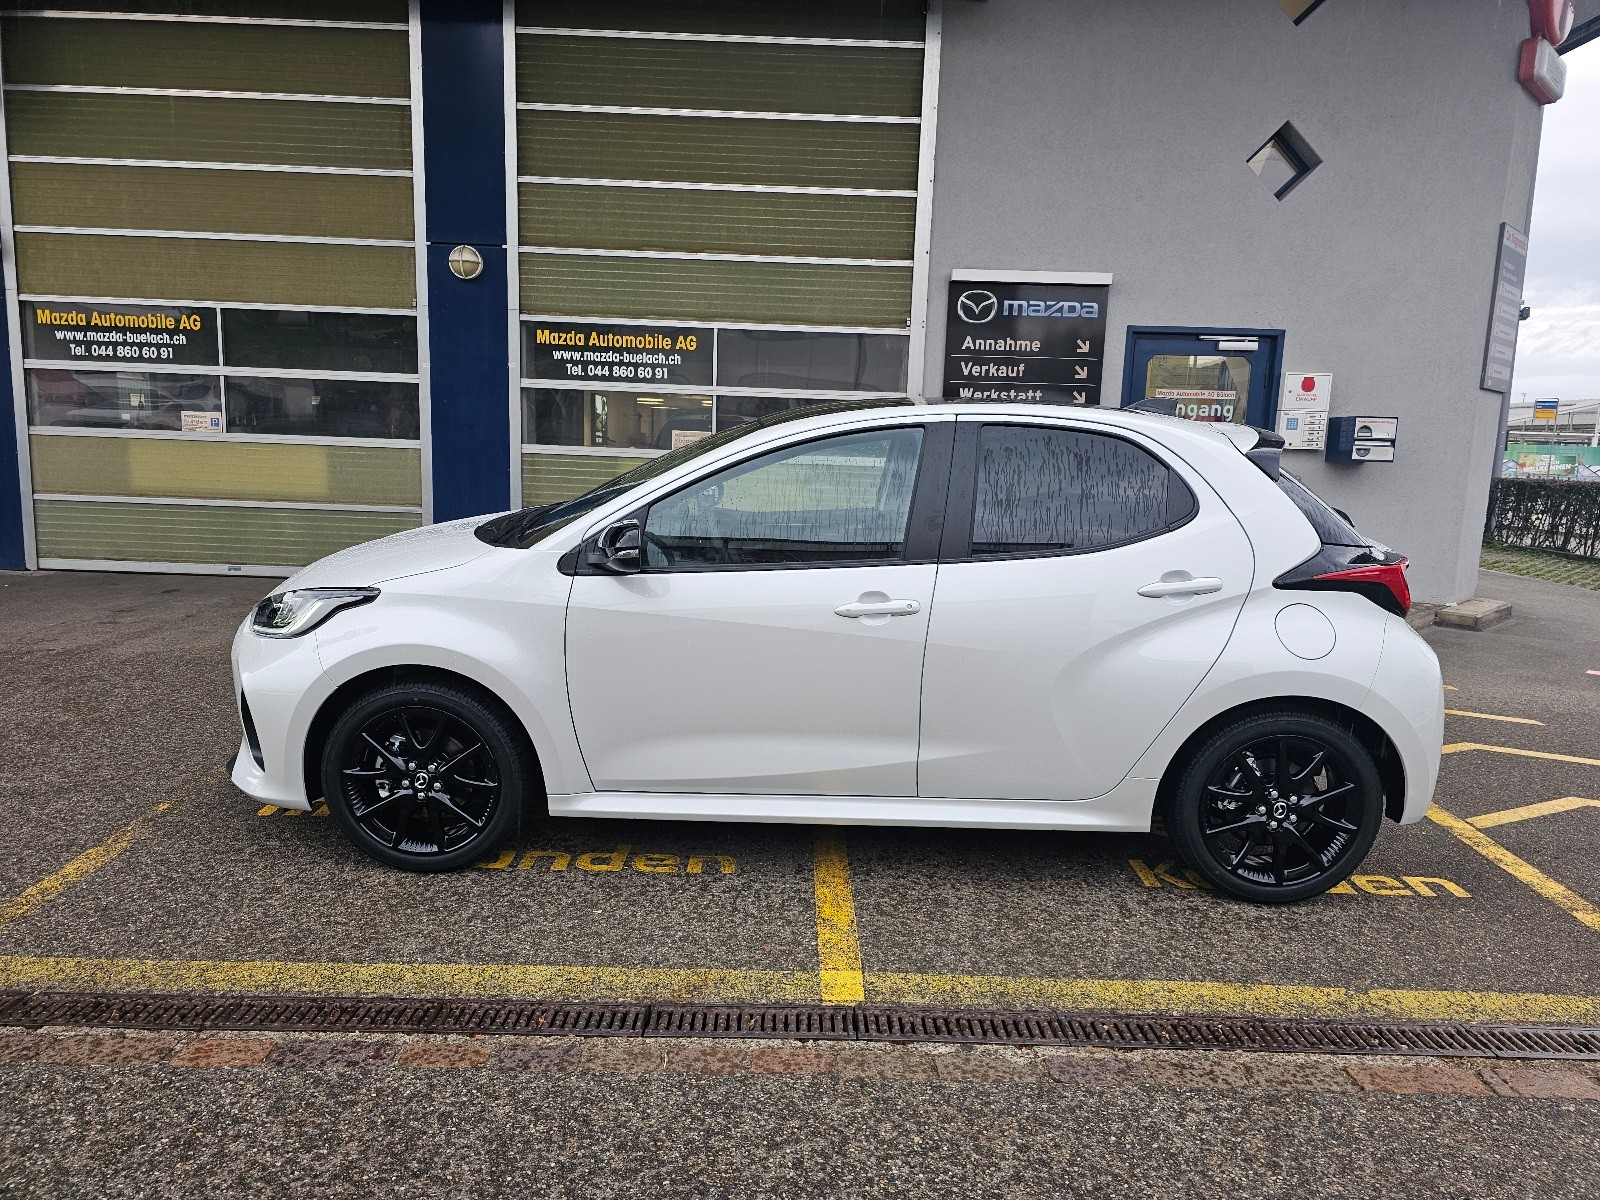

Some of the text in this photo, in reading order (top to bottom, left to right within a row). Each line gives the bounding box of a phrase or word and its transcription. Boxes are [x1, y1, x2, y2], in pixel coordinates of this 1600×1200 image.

[1003, 300, 1099, 318] mazda
[36, 309, 201, 331] Mazda Automobile AG
[54, 330, 187, 344] www.mazda-buelach.ch
[536, 329, 698, 351] Mazda Automobile AG
[961, 335, 1041, 352] Annahme
[70, 344, 174, 359] Tel. 044 860 60 91
[552, 350, 681, 365] www.mazda-buelach.ch
[566, 364, 668, 379] Tel. 044 860 60 91
[960, 361, 1025, 377] Verkauf
[1175, 403, 1234, 422] ngang
[474, 844, 738, 874] unden
